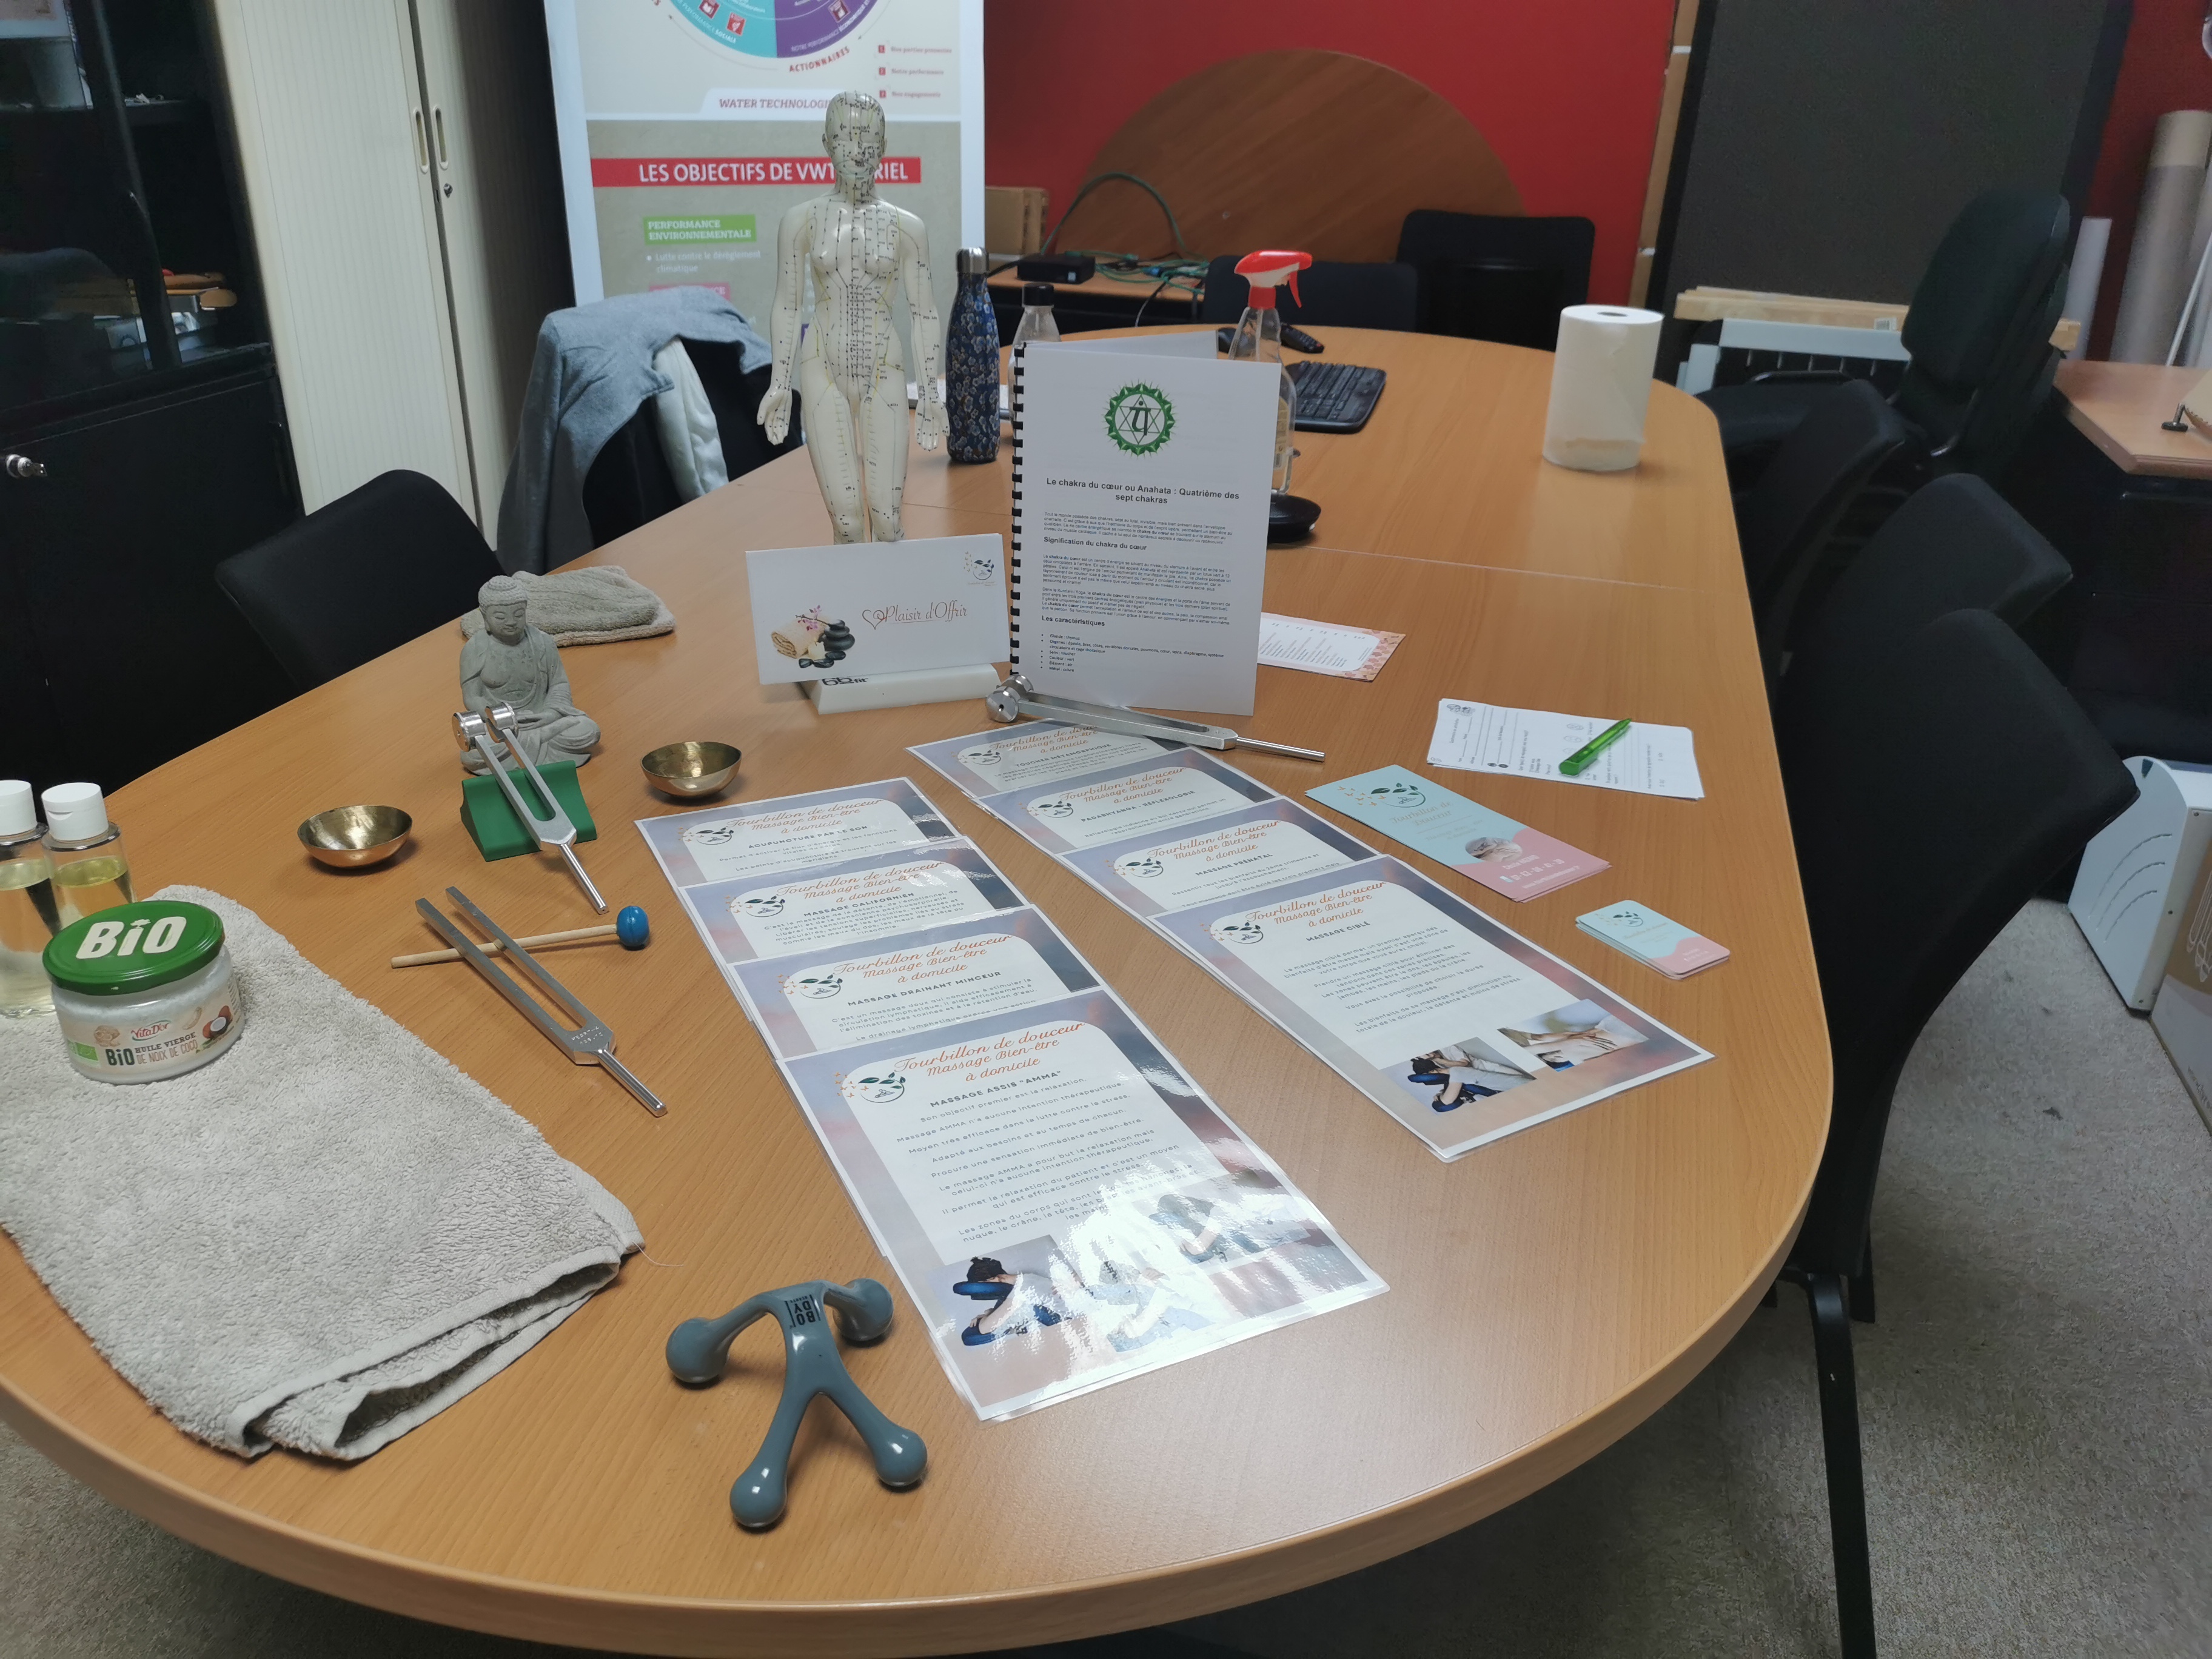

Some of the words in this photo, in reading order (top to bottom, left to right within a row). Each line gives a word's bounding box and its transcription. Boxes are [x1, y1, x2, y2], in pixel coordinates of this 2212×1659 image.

[789, 46, 850, 72] ACTIONNAIRES
[720, 99, 757, 108] WATER
[760, 99, 831, 108] TECHNOLOGI
[639, 164, 669, 183] LES
[674, 163, 766, 182] OBJECTIFS
[770, 163, 793, 181] DE
[796, 163, 836, 181] VWT
[874, 163, 908, 179] RIEL
[648, 220, 721, 230] PERFORMANCE
[649, 230, 752, 240] ENVIRONNEMENTALE
[1059, 478, 1086, 488] chakra
[1138, 485, 1171, 494] Anahata
[1179, 488, 1222, 498] Quatrième
[1116, 494, 1133, 503] sept
[1136, 495, 1168, 504] chakras
[1044, 537, 1084, 546] Signification
[885, 605, 921, 622] Plaisir
[925, 600, 967, 622] d'Offrir
[1055, 617, 1105, 626] caractéristiques
[1015, 756, 1050, 767] TOUCHER
[1059, 782, 1123, 801] Tourbillon
[1142, 767, 1186, 782] douceur
[1123, 788, 1164, 802] domicile
[748, 834, 815, 849] ACUPUNCTURE
[1147, 837, 1215, 859] Tourbillon
[1217, 832, 1232, 840] de
[1235, 820, 1281, 836] douceur
[1216, 843, 1258, 860] domicile
[1196, 863, 1233, 876] MASSAGE
[1234, 853, 1273, 866] PRÉNATAL
[776, 878, 862, 896] Tourbillon
[886, 862, 944, 876] douceur
[849, 886, 902, 901] domicile
[1245, 899, 1317, 923] Tourbillon
[1320, 893, 1335, 903] de
[1338, 882, 1386, 899] douceur
[803, 905, 850, 917] MASSAGE
[853, 893, 914, 908] CALIFORNIEN
[1274, 907, 1323, 925] Massage
[1319, 907, 1364, 925] domicile
[1306, 929, 1346, 942] MASSAGE
[1347, 920, 1370, 930] CIBLÉ
[833, 953, 924, 975] Tourbillon
[927, 947, 946, 957] de
[950, 935, 1013, 952] douceur
[863, 962, 923, 979] Massage
[911, 964, 968, 980] domicile
[848, 994, 897, 1006] MASSAGE
[900, 982, 952, 996] DRAINANT
[955, 971, 1002, 984] MINCEUR
[135, 1044, 162, 1054] HUILE
[165, 1032, 196, 1048] VIERGE
[137, 1053, 147, 1064] DE
[149, 1049, 167, 1062] NOIX
[170, 1045, 179, 1057] DE
[182, 1041, 198, 1054] COCO
[894, 1045, 990, 1073] Tourbillon
[994, 1037, 1014, 1049] de
[1018, 1022, 1085, 1044] douceur
[927, 1056, 991, 1076] Massage
[996, 1039, 1059, 1061] Bien-être
[965, 1073, 976, 1082] à
[980, 1057, 1041, 1078] domicile
[930, 1090, 983, 1107] MASSAGE
[987, 1082, 1017, 1093] ASSIS
[1019, 1070, 1061, 1084] "AMMA"
[940, 1105, 975, 1118] objectif
[978, 1096, 1011, 1108] premier
[1041, 1079, 1087, 1092] relaxation.
[897, 1129, 937, 1142] Massage
[940, 1120, 967, 1132] AMMA
[985, 1108, 1016, 1121] aucune
[1019, 1098, 1059, 1111] intention
[1061, 1081, 1124, 1100] thérapeutique.
[909, 1143, 939, 1154] Moyen
[942, 1136, 960, 1145] très
[963, 1127, 1000, 1139] efficace
[1003, 1120, 1024, 1130] dans
[1037, 1111, 1057, 1121] lutte
[1061, 1104, 1088, 1114] contre
[1101, 1094, 1130, 1104] stress.
[931, 1164, 968, 1178] Procure
[971, 1159, 988, 1168] une
[991, 1147, 1035, 1163] sensation
[1037, 1133, 1085, 1150] immédiate
[1101, 1118, 1144, 1133] bien-être.
